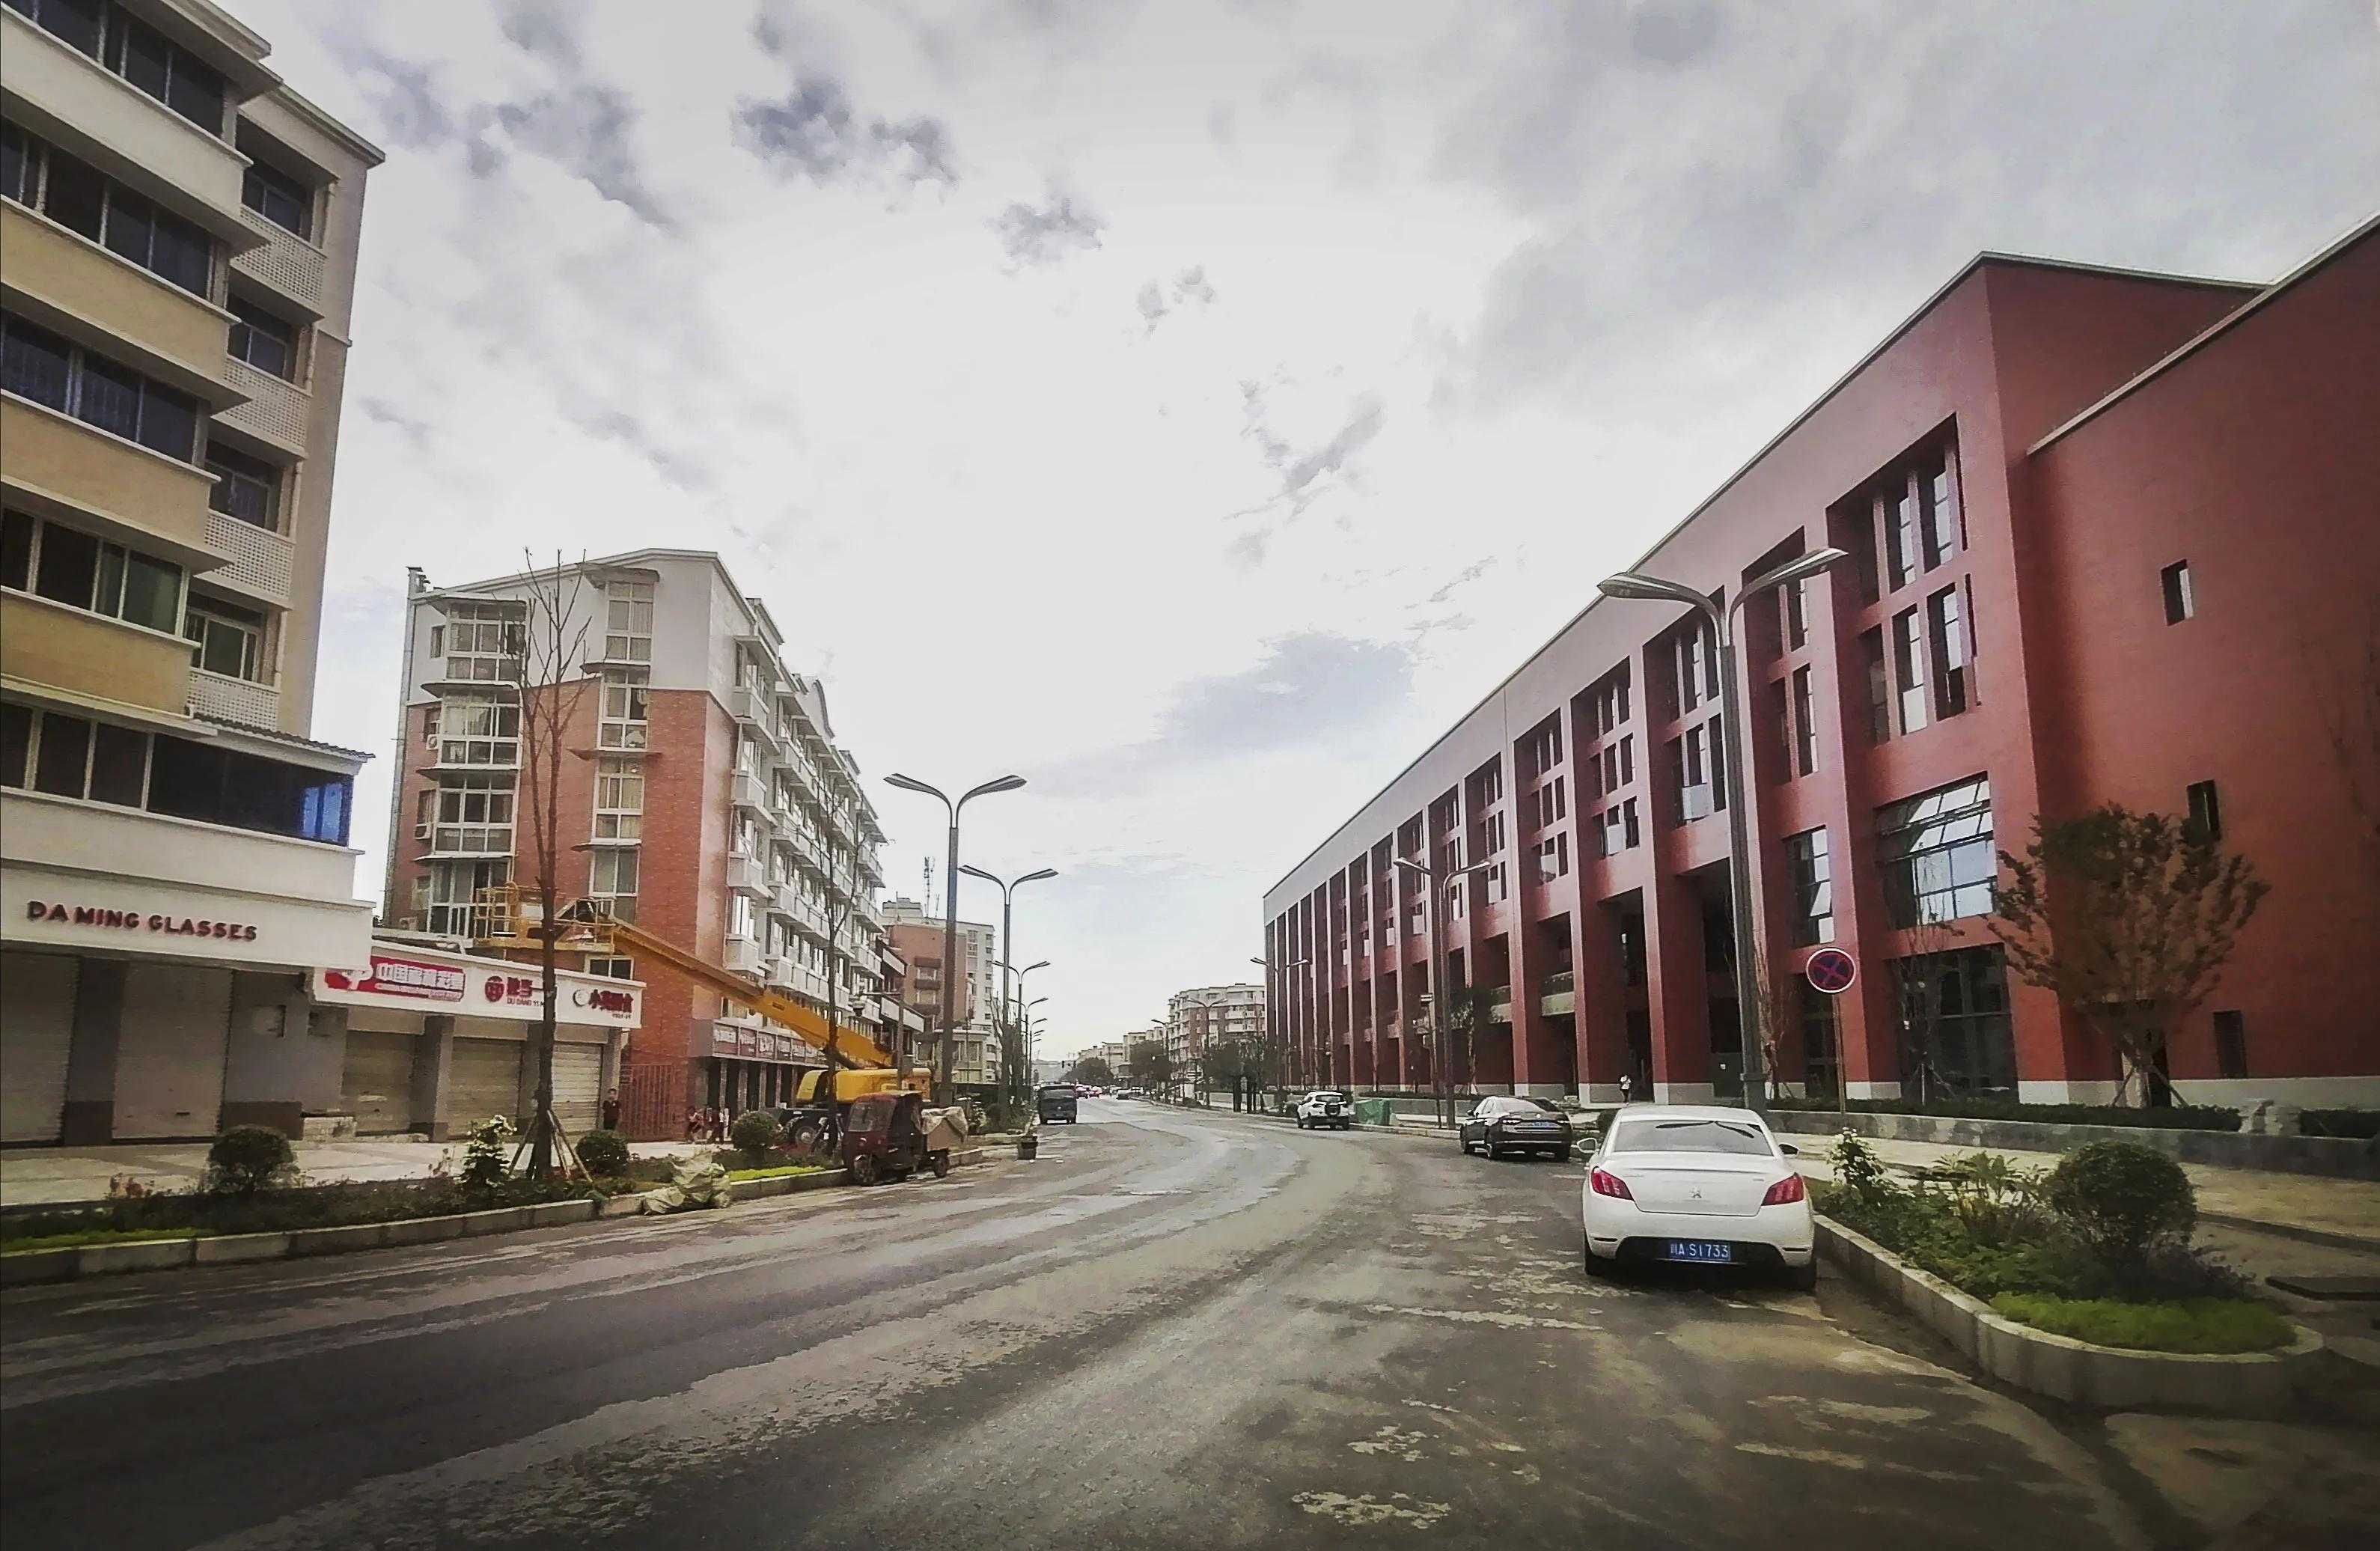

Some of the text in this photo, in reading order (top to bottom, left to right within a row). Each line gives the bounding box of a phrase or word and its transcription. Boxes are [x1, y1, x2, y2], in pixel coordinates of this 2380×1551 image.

[27, 901, 258, 942] DA MING GLASSES
